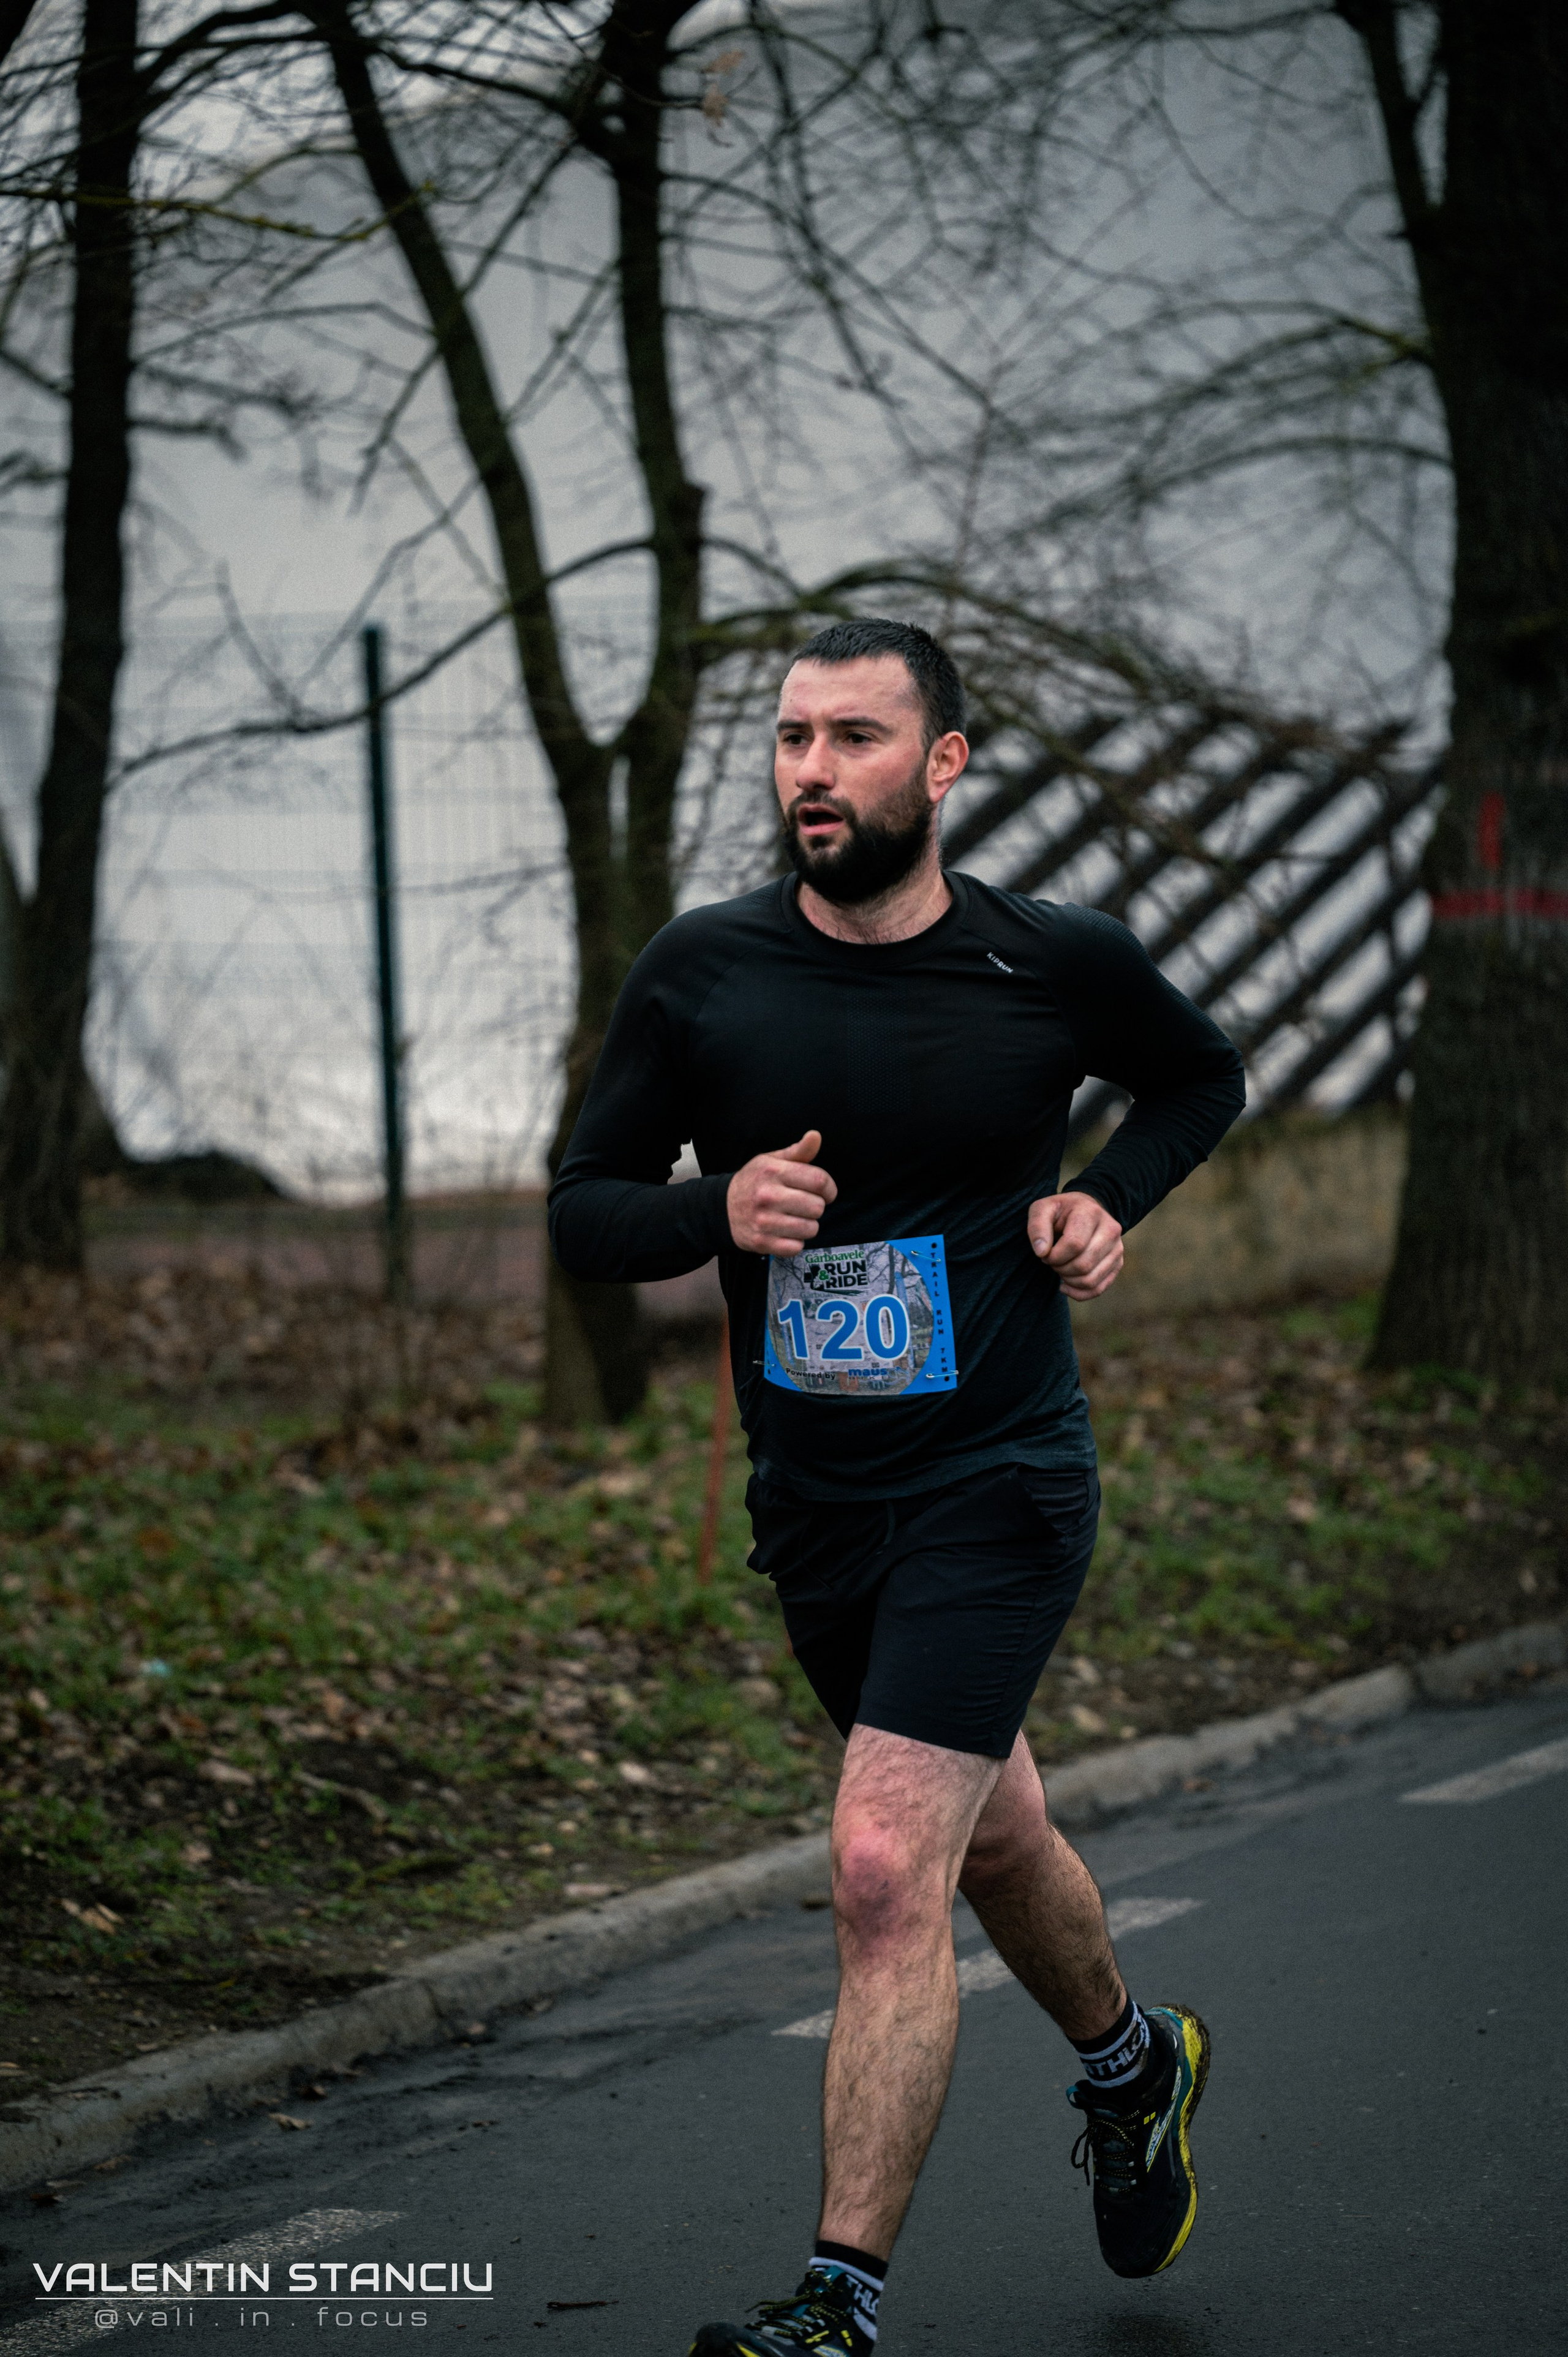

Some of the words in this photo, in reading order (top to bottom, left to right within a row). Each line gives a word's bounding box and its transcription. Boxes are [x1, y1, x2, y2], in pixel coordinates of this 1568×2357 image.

[987, 952, 1013, 973] KIPRUN
[805, 1250, 865, 1263] Gârboavele
[824, 1259, 867, 1275] RUN
[930, 1252, 940, 1297] TRAIL
[826, 1273, 868, 1288] RIDE
[778, 1294, 908, 1360] 120
[786, 1367, 822, 1378] Powered
